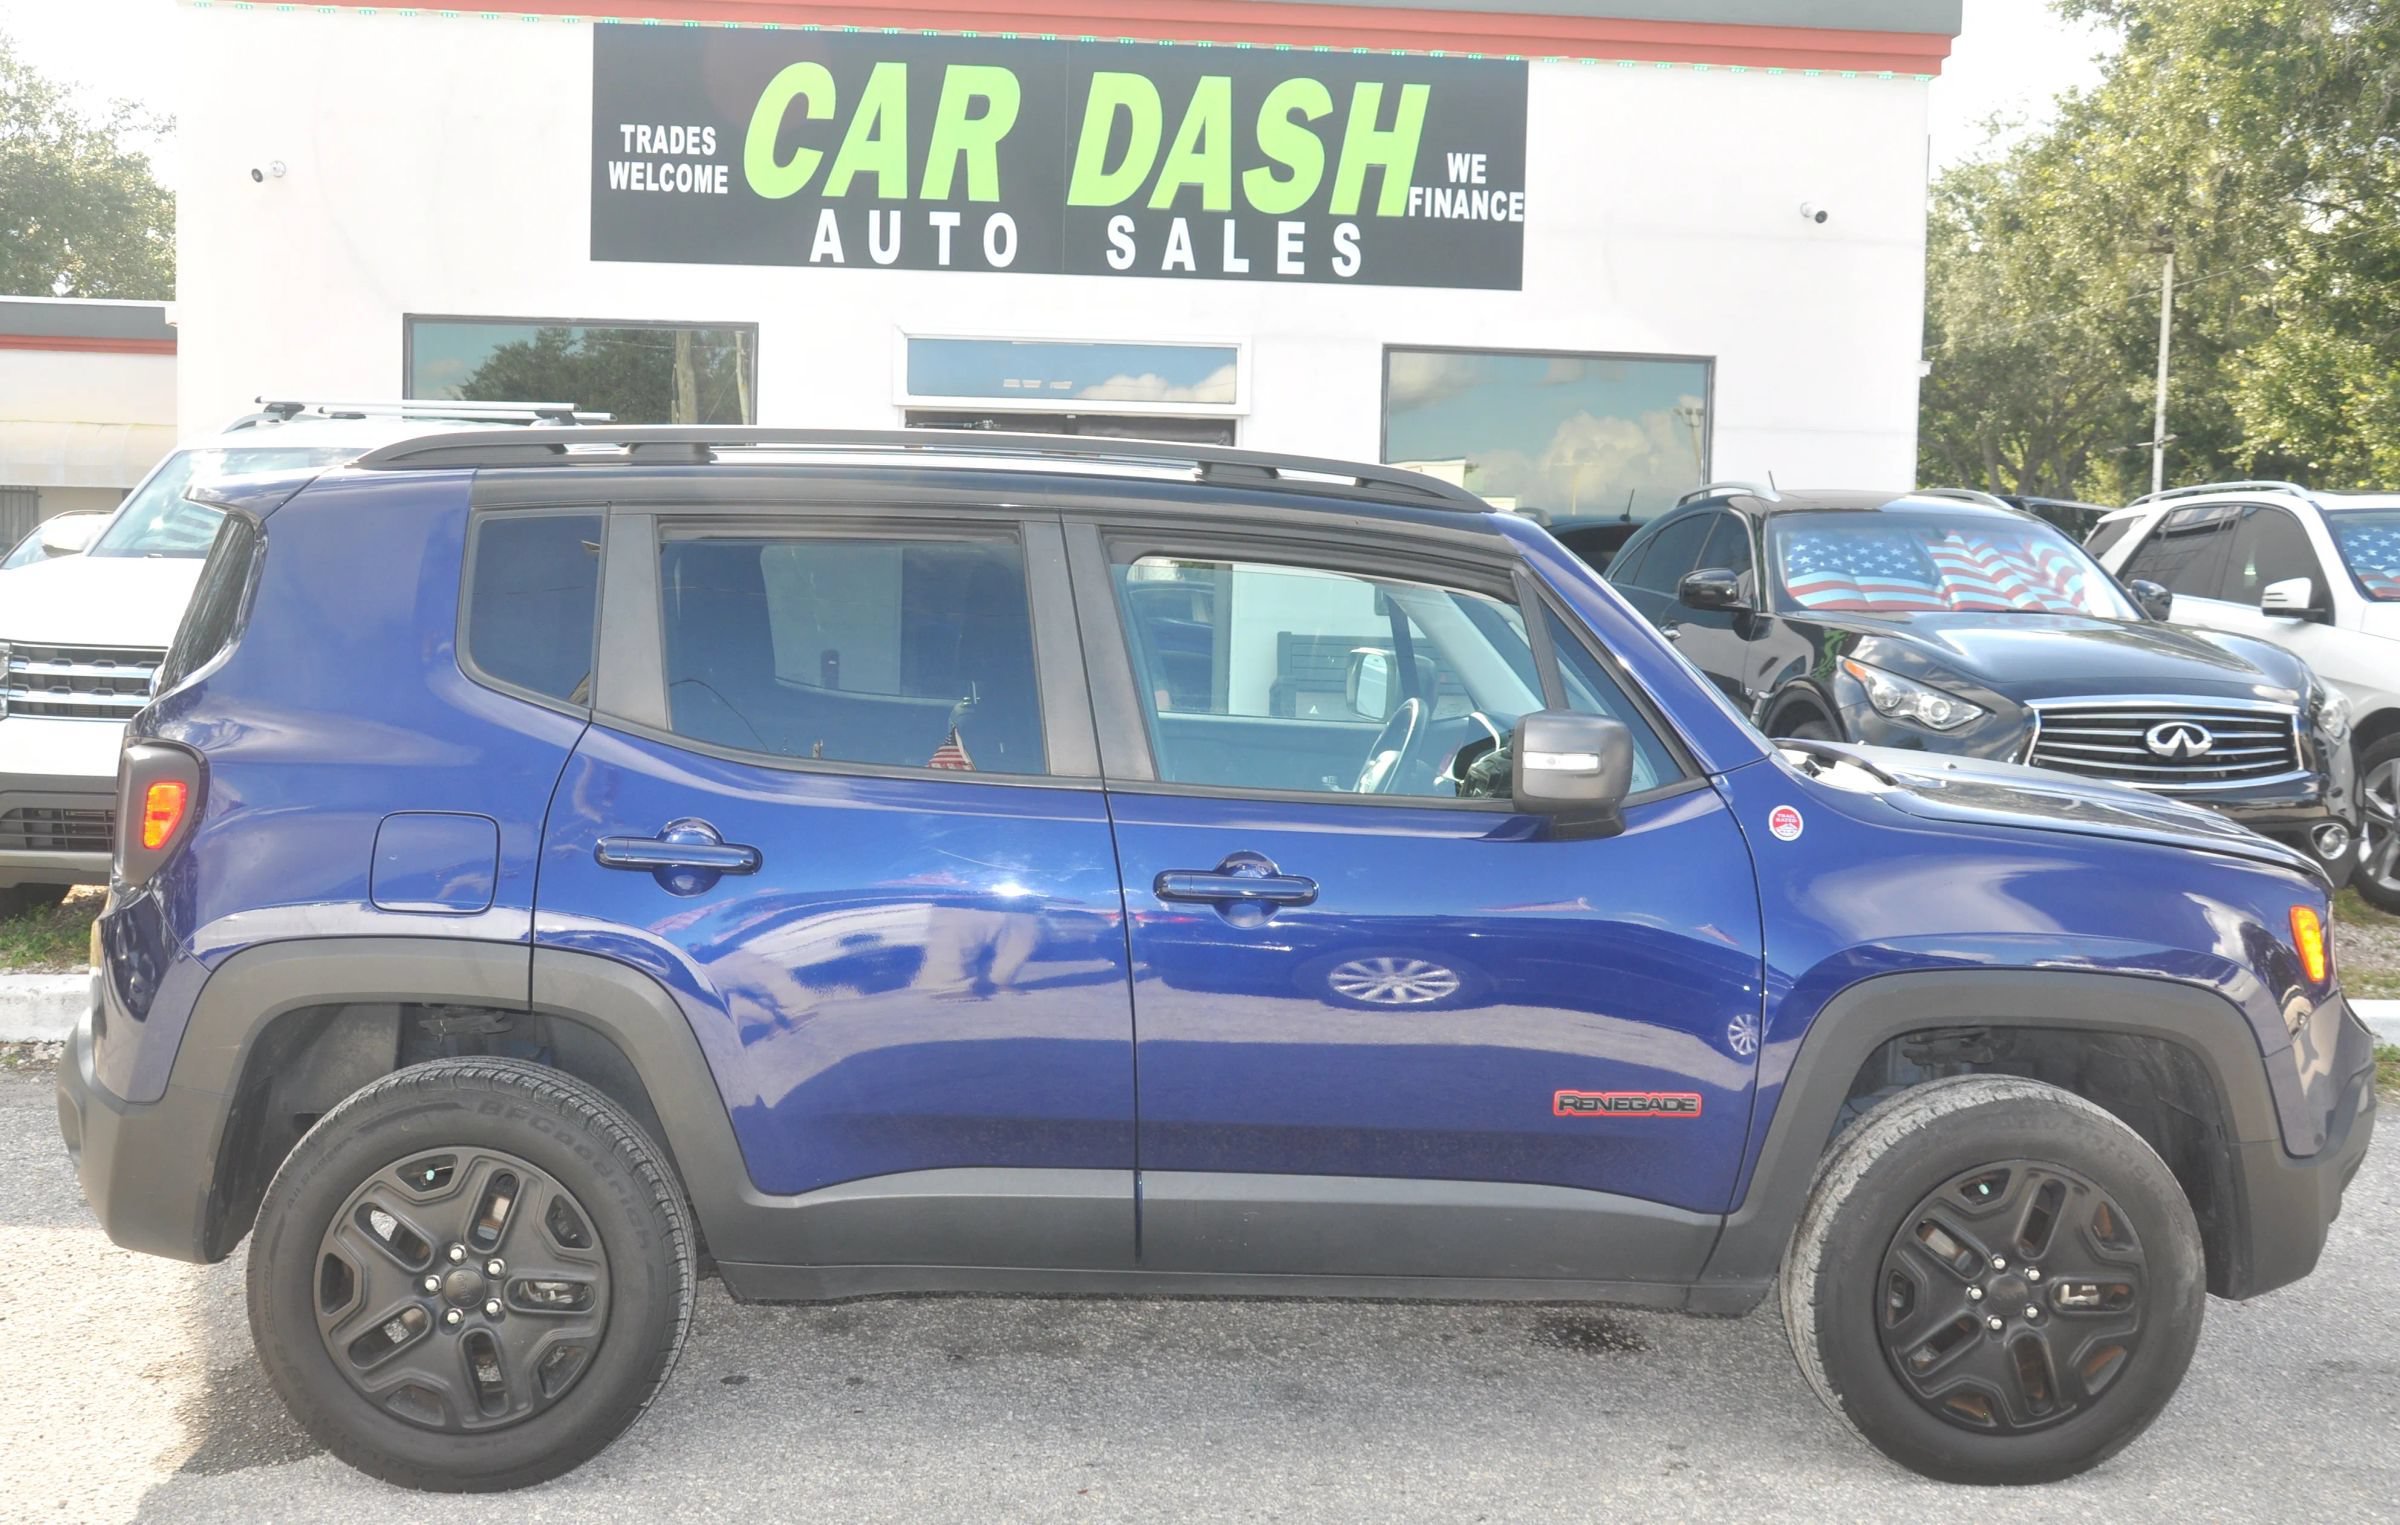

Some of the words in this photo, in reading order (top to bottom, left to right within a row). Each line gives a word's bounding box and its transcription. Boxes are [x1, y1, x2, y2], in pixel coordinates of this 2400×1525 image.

[620, 124, 717, 156] TRADES
[743, 61, 1021, 202] CAR
[1067, 71, 1431, 217] DASH
[608, 161, 729, 195] WELCOME
[1447, 153, 1487, 184] WE
[1408, 187, 1525, 222] FINANCE
[809, 208, 1018, 268] AUTO
[1106, 214, 1362, 277] SALES
[1556, 1093, 1699, 1113] RENEGADE
